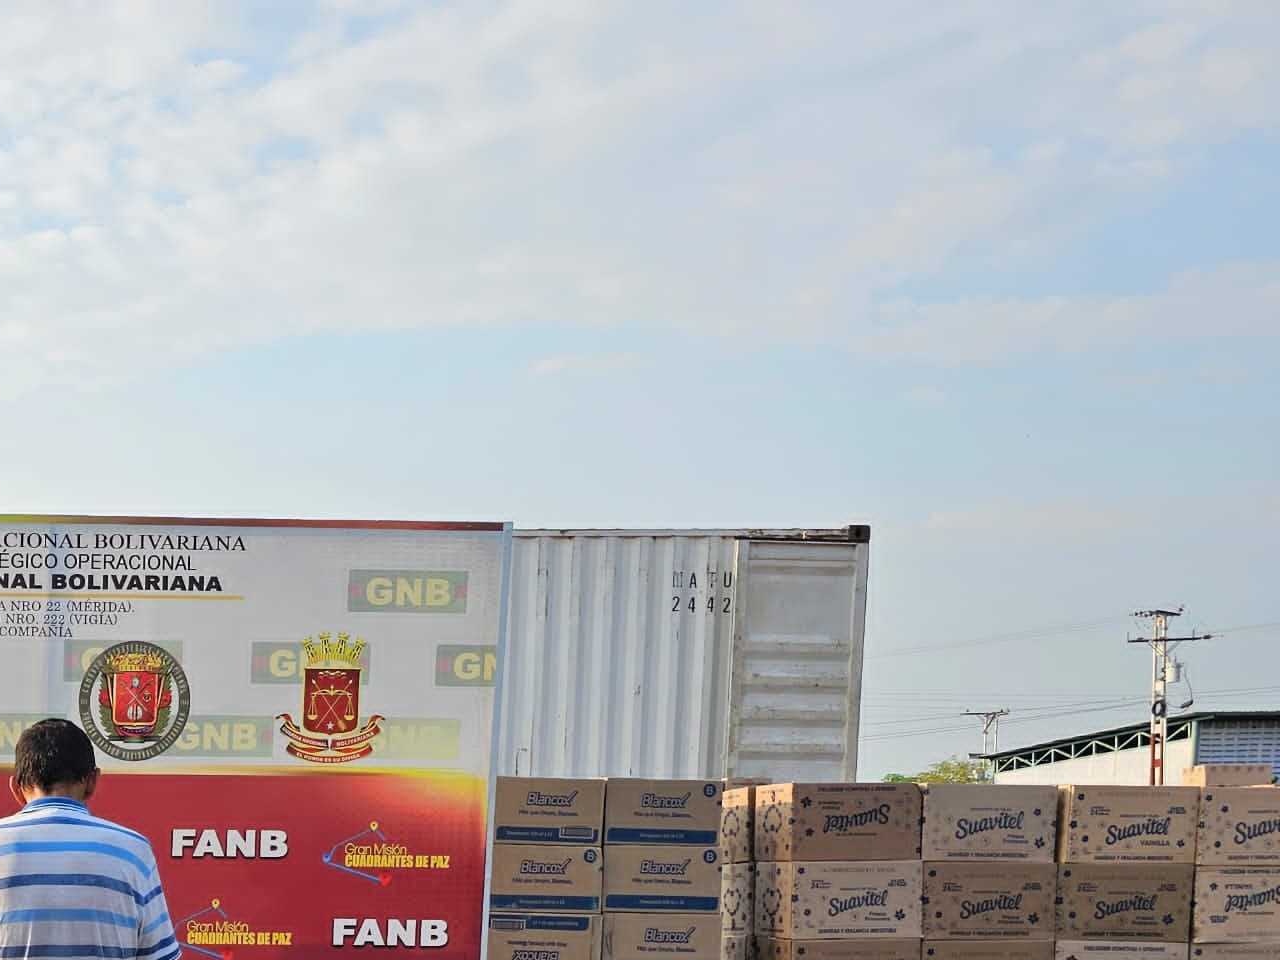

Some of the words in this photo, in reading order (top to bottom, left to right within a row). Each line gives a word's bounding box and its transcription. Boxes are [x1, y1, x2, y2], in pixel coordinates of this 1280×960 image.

[95, 534, 246, 551] BOLIVARIANA
[64, 554, 197, 571] OPERACIONAL
[51, 573, 223, 592] BOLIVARIANA
[366, 577, 450, 607] GNB
[10, 600, 41, 612] NRO
[46, 601, 62, 612] 22
[43, 614, 65, 625] 222
[175, 722, 257, 751] GNB
[527, 790, 579, 807] Blancox
[641, 792, 691, 809] Blancox
[171, 829, 289, 859] FANB
[344, 843, 373, 855] Gran
[375, 843, 407, 856] Misión
[344, 855, 414, 868] CUADRANTES
[415, 856, 428, 868] DE
[430, 856, 450, 868] PAZ
[520, 857, 572, 875] Blancox
[640, 858, 691, 875] Blancox
[186, 920, 213, 933] Gran
[215, 921, 249, 934] Misión
[332, 918, 449, 948] FANB
[644, 926, 696, 944] Blancox
[187, 932, 255, 945] CUADRANTES
[257, 932, 271, 945] DE
[272, 933, 292, 945] PAZ
